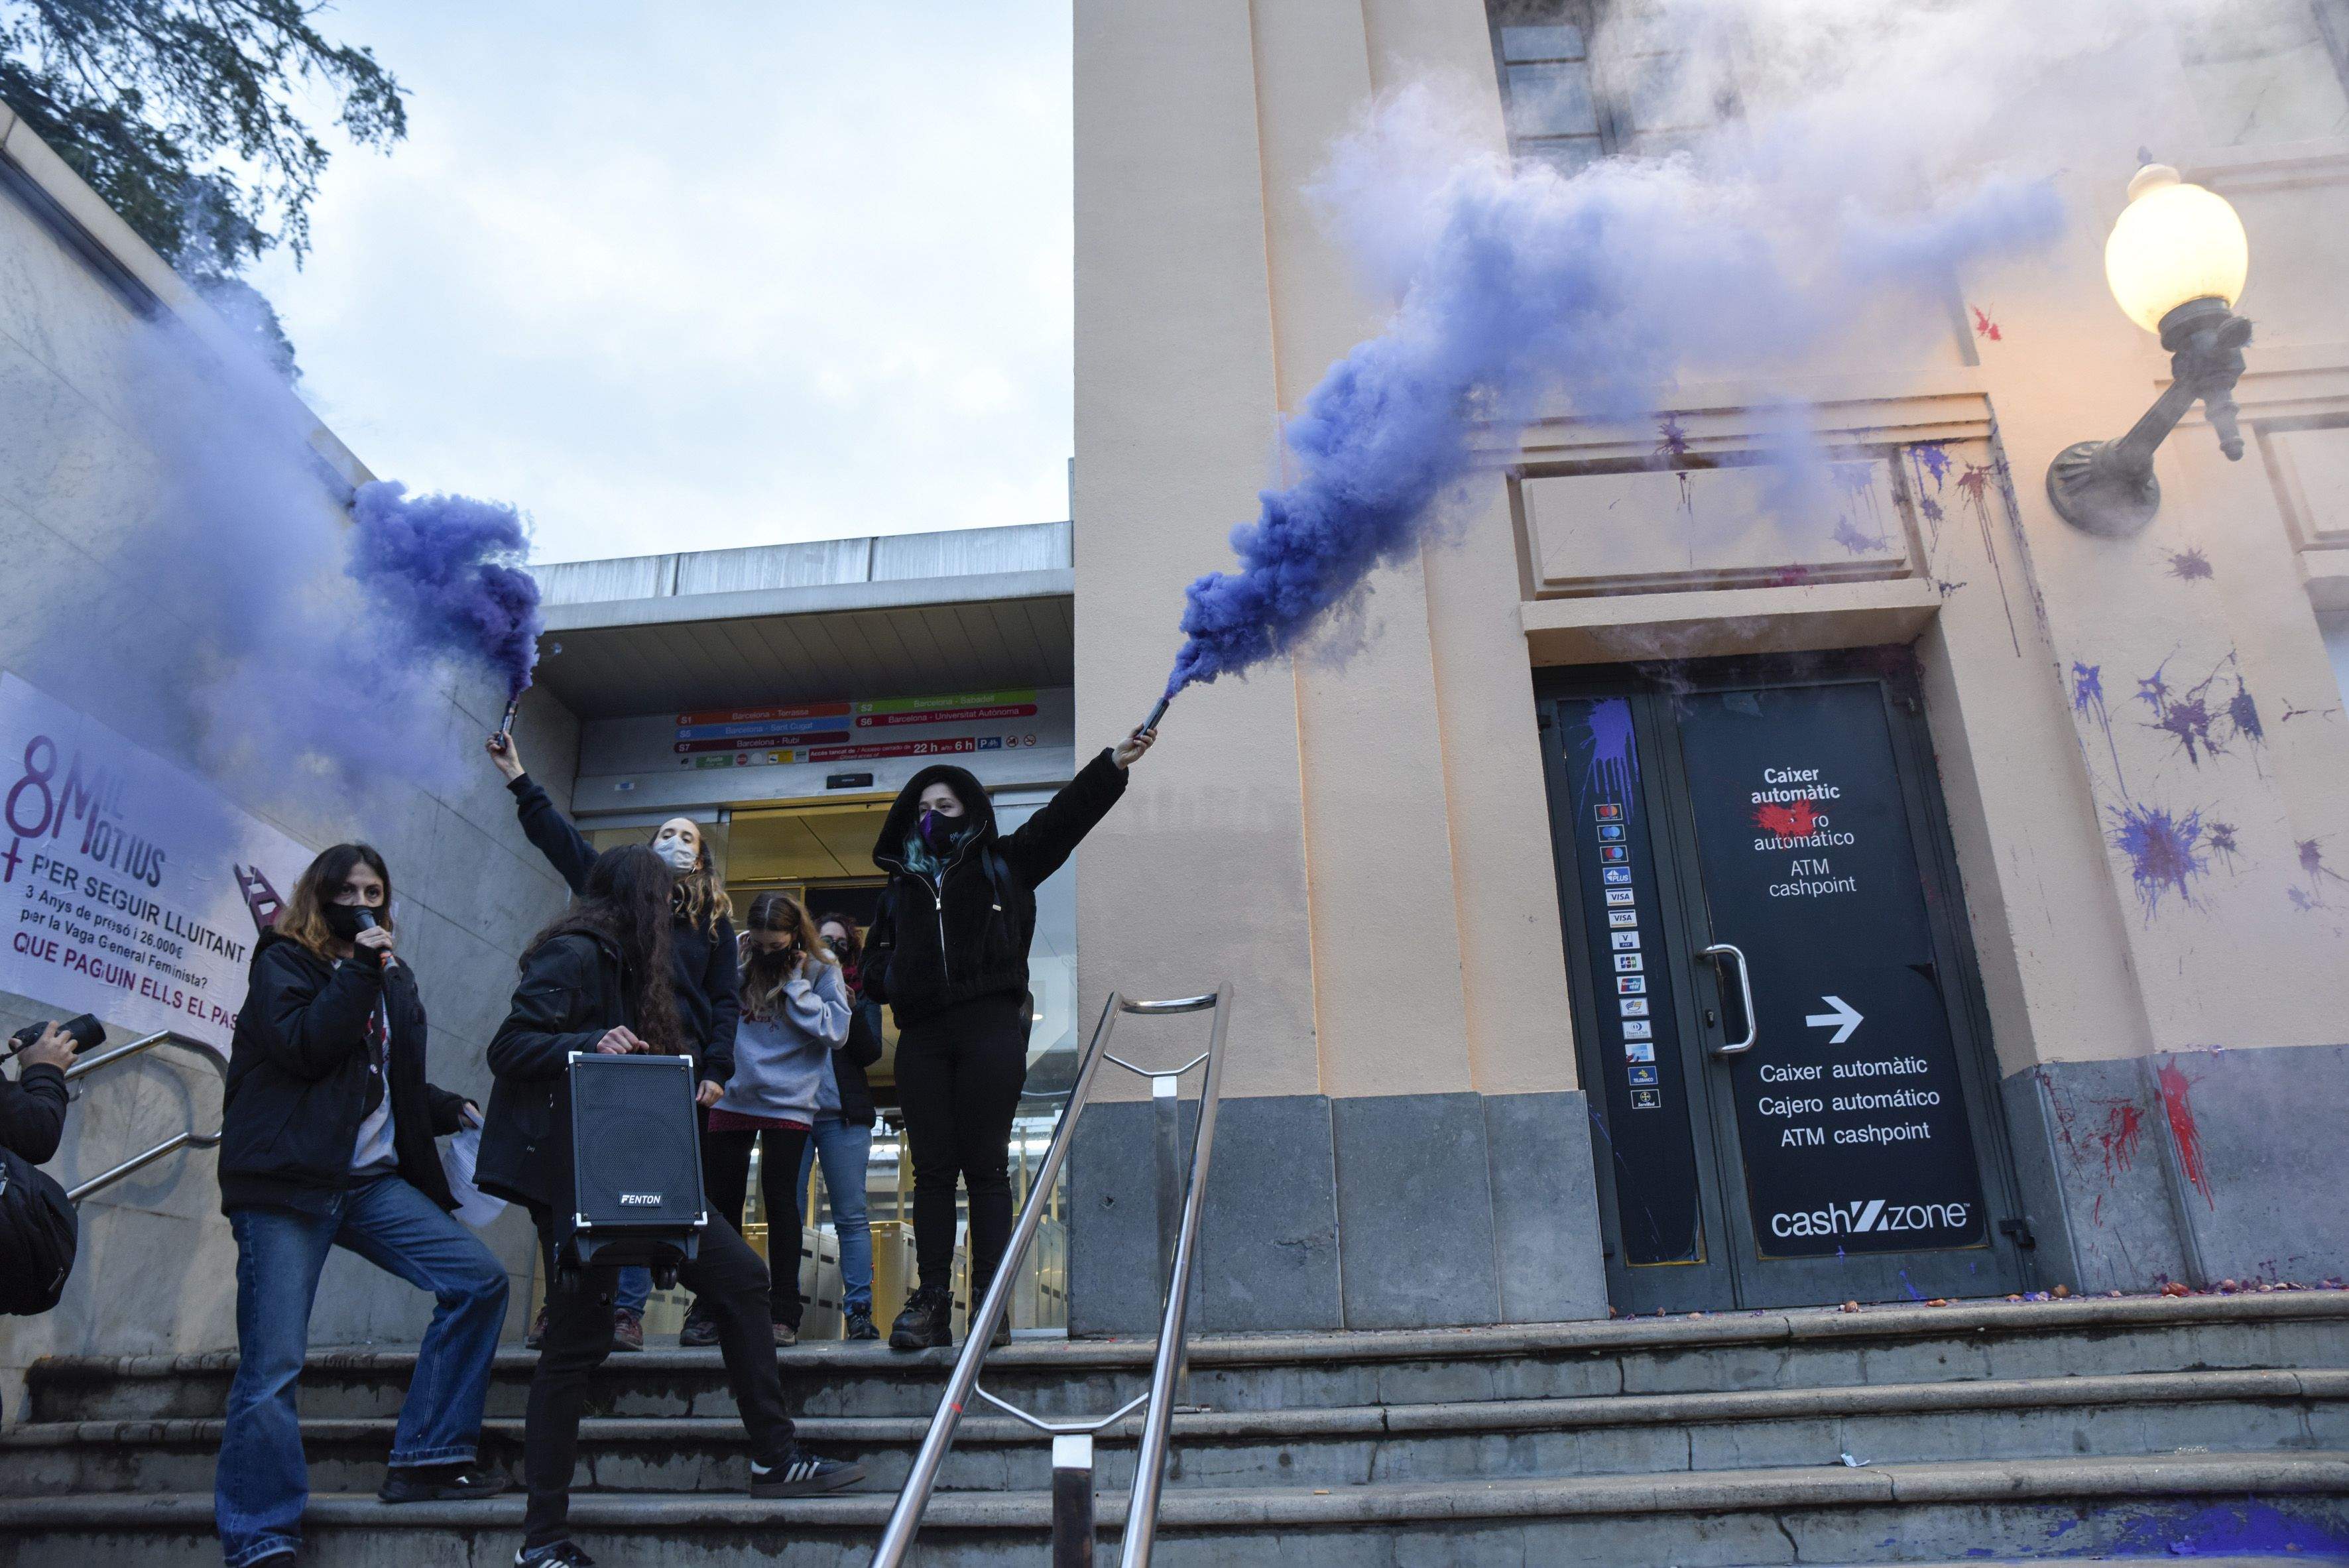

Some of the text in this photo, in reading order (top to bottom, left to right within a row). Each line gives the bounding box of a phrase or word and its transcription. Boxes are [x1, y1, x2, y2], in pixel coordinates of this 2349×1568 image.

[961, 695, 994, 704] Sabadell
[732, 711, 770, 720] Barcelona
[888, 715, 927, 724] Barcelona
[935, 711, 976, 720] Universitat
[725, 725, 763, 734] Barcelona
[790, 721, 813, 731] Cugat
[737, 738, 774, 747] Barcelona
[914, 744, 928, 753] 22
[931, 743, 938, 753] h
[955, 742, 962, 751] 6
[965, 741, 973, 750] h
[981, 739, 987, 748] P
[1764, 767, 1819, 784] Caixer
[1751, 784, 1840, 804] automàtic
[1754, 830, 1854, 851] automático
[1791, 858, 1829, 876] ATM
[1770, 876, 1856, 898] cashpoint
[25, 885, 184, 959] 3 Anys de presó i 26.000€
[84, 876, 160, 925] SEGUIR
[164, 911, 245, 963] LLUITANT
[20, 909, 208, 989] per la Vaga General Feminista?
[1620, 957, 1636, 967] JCB
[13, 932, 59, 963] QUE
[63, 948, 136, 991] PAGUIN
[141, 977, 184, 1009] ELLS
[187, 996, 206, 1019] EL
[1760, 1056, 1928, 1083] Caixer automàtic
[1758, 1089, 1940, 1118] Cajero automático
[1781, 1122, 1930, 1147] ATM cashpoint
[621, 1194, 661, 1204] FENTON
